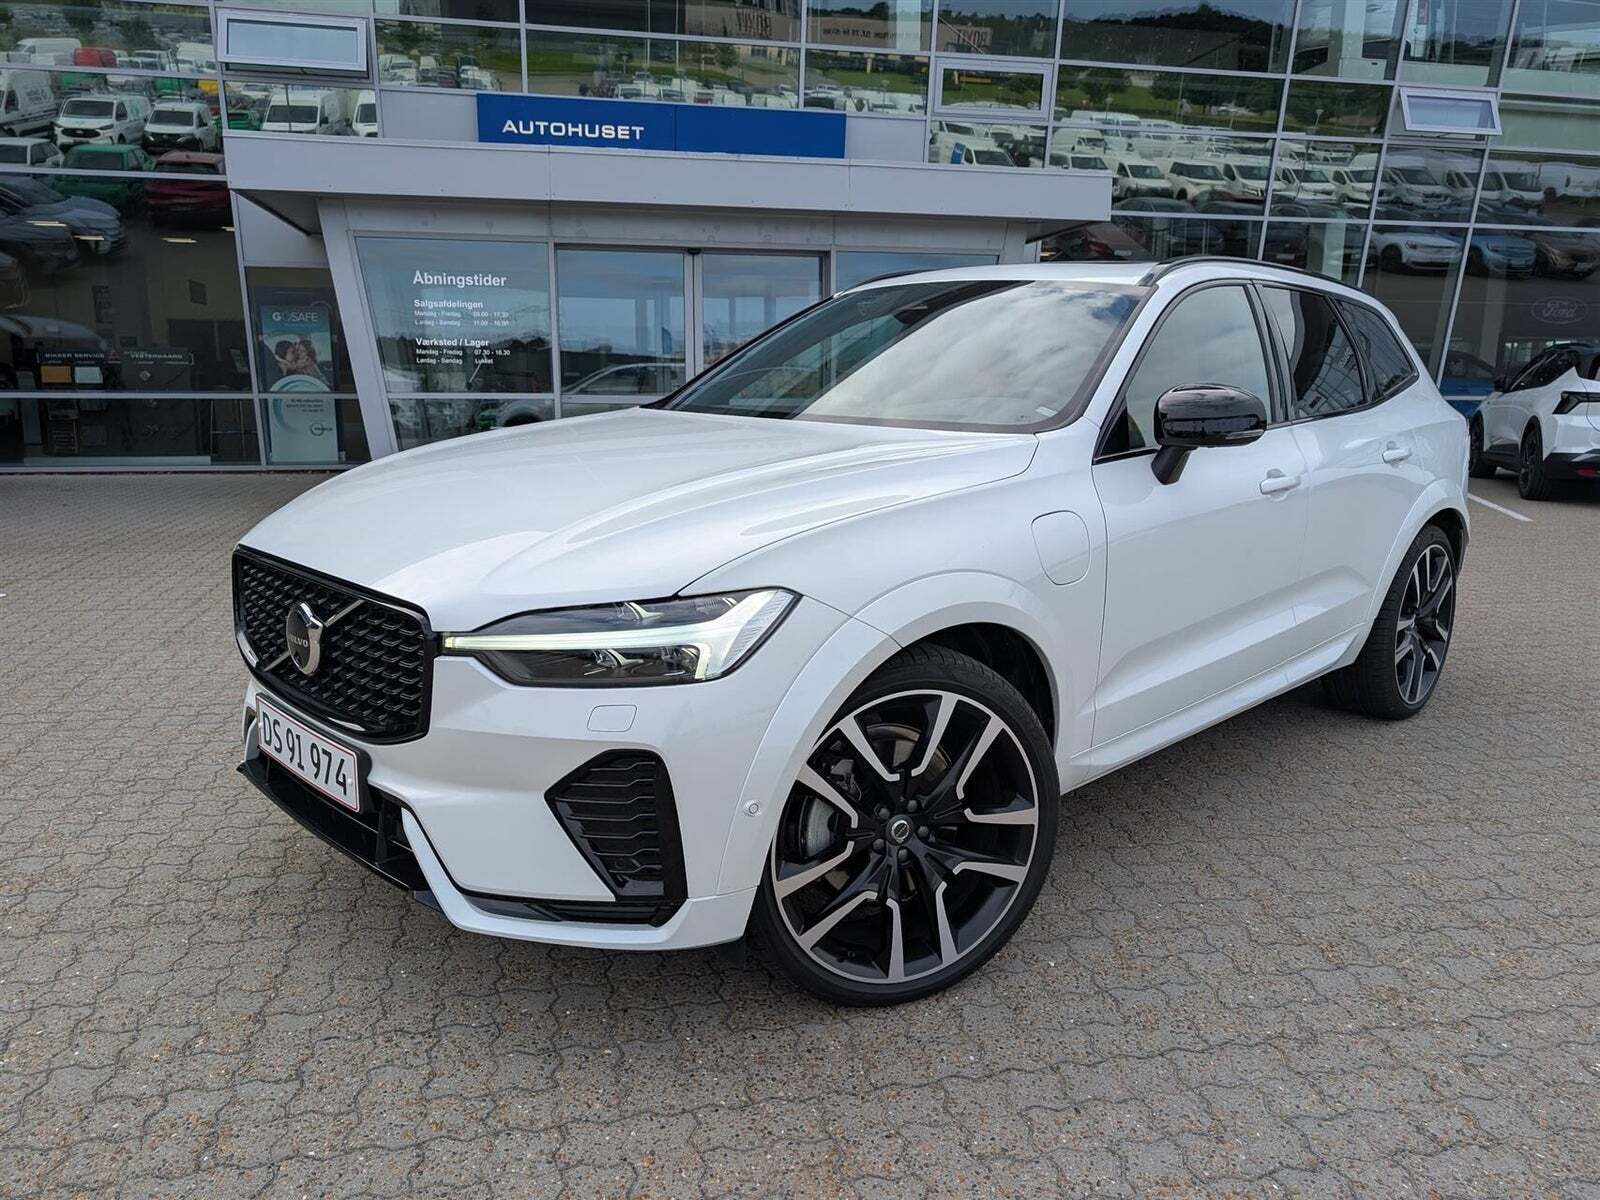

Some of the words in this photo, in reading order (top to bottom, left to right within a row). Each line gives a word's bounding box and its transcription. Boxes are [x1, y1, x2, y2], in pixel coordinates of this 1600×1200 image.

[502, 120, 644, 140] AUTOHUSET
[413, 270, 506, 288] Åbningstider
[414, 300, 484, 310] Salgsafdelingen
[464, 339, 489, 347] Lager
[262, 712, 282, 754] DS
[286, 728, 304, 771] 91
[310, 742, 347, 795] 974
